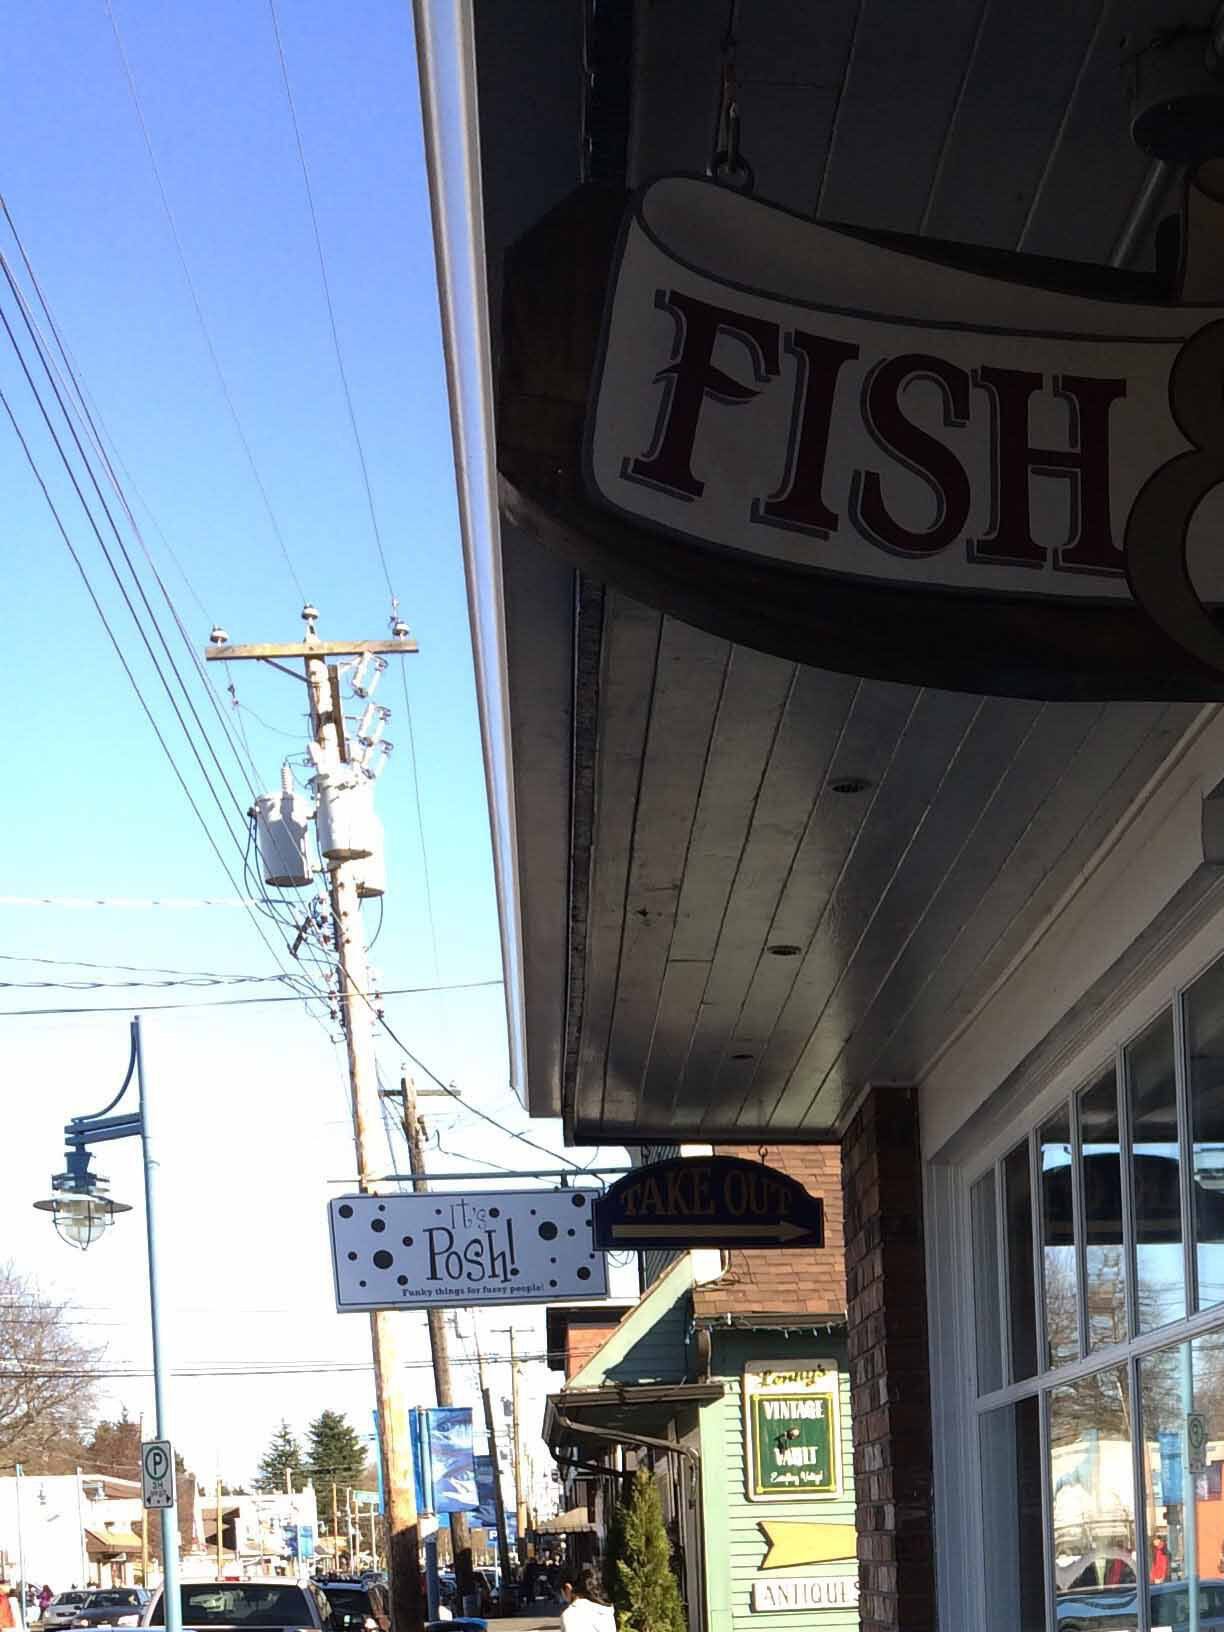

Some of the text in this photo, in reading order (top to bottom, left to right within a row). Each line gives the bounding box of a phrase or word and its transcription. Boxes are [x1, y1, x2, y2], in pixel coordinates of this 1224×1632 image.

[620, 289, 1128, 577] FISH
[622, 1167, 793, 1216] TAKE OUT
[423, 1218, 519, 1283] Posh!
[762, 1400, 824, 1420] VINTAGE
[152, 1452, 162, 1475] P
[773, 1446, 819, 1467] VAULT
